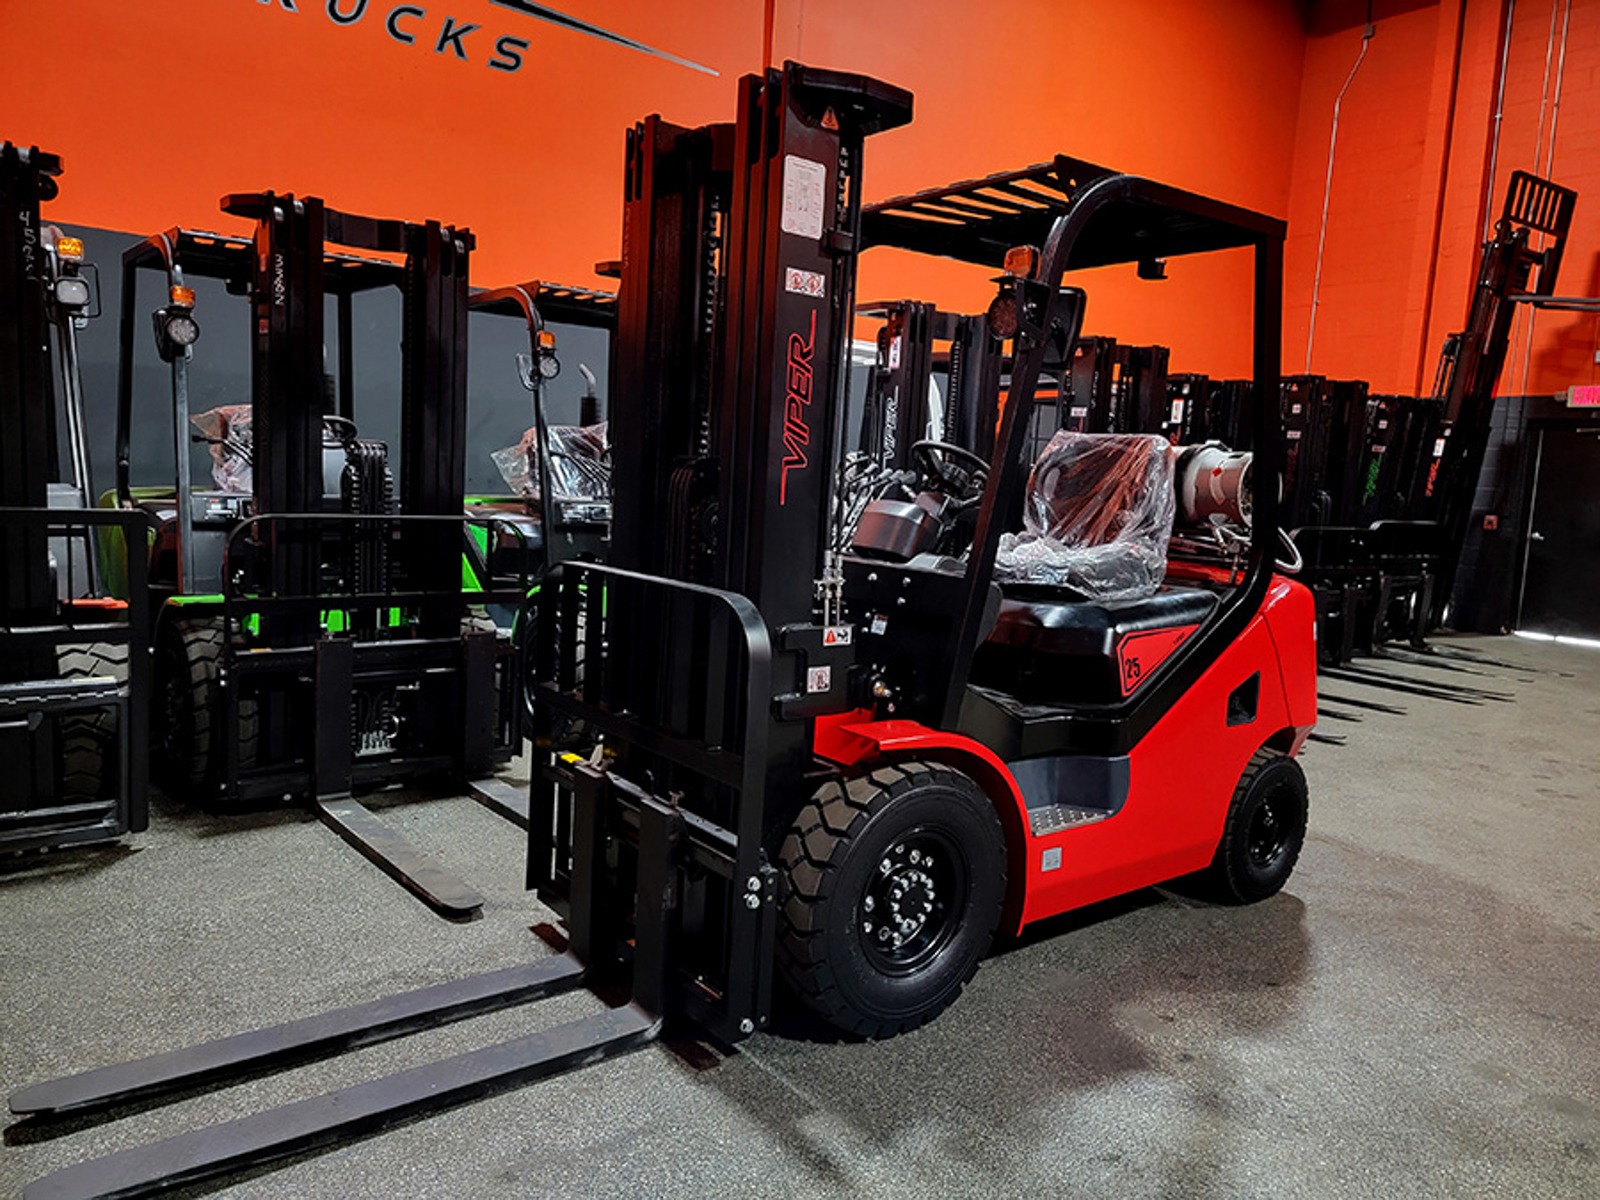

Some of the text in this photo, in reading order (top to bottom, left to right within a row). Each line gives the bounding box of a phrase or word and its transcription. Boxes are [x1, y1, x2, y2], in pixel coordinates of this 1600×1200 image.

[257, 0, 531, 72] UCKS
[780, 310, 817, 505] VIPER
[882, 385, 899, 470] VIPER
[1125, 657, 1141, 678] 25
